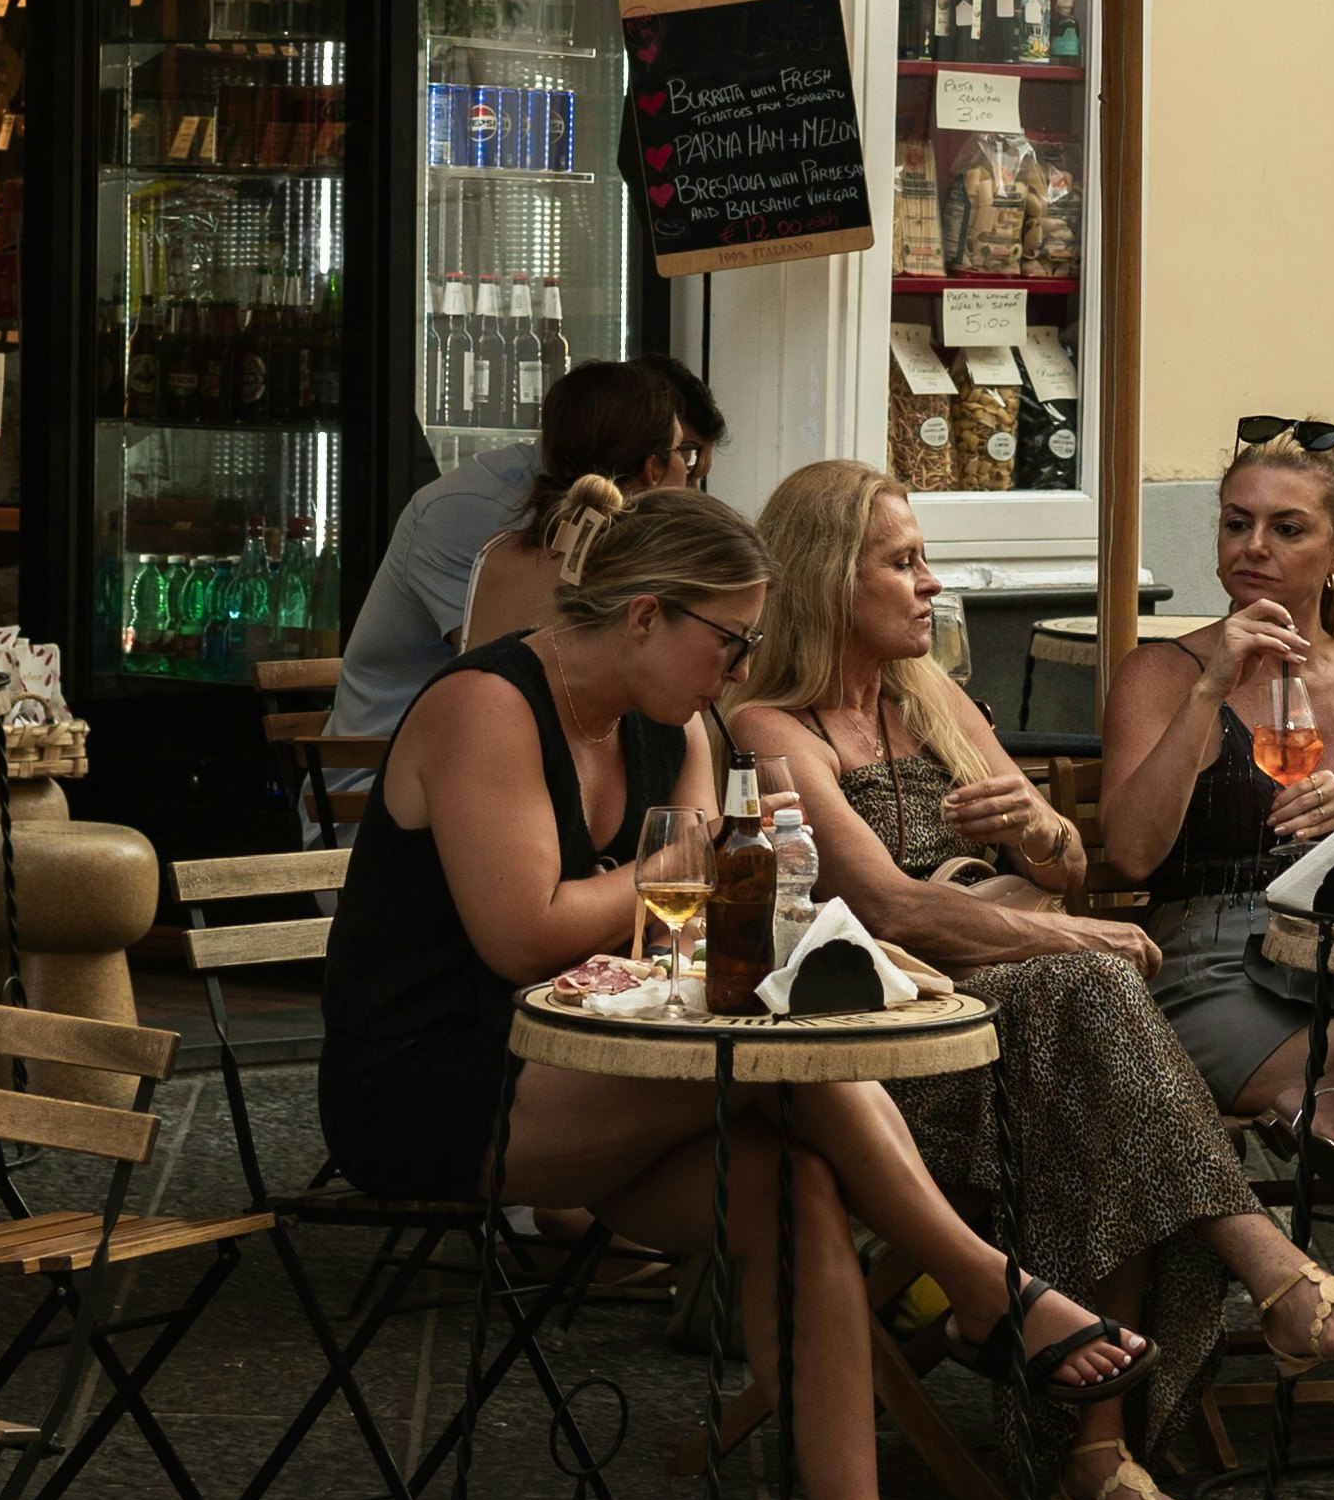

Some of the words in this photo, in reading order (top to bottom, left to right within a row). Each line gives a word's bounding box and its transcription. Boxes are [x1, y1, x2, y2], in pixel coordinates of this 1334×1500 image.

[666, 77, 745, 114] BURRATA
[779, 66, 832, 92] FRESH
[944, 78, 974, 93] PASTA
[692, 106, 754, 126] TOMATOES
[674, 131, 743, 166] PARMA
[748, 124, 785, 158] HAM
[674, 173, 766, 204] BRESAOLA
[691, 205, 719, 222] AND
[725, 195, 802, 221] BALSAMIC
[806, 185, 859, 207] VINEGAR
[752, 241, 814, 261] ITALIANO
